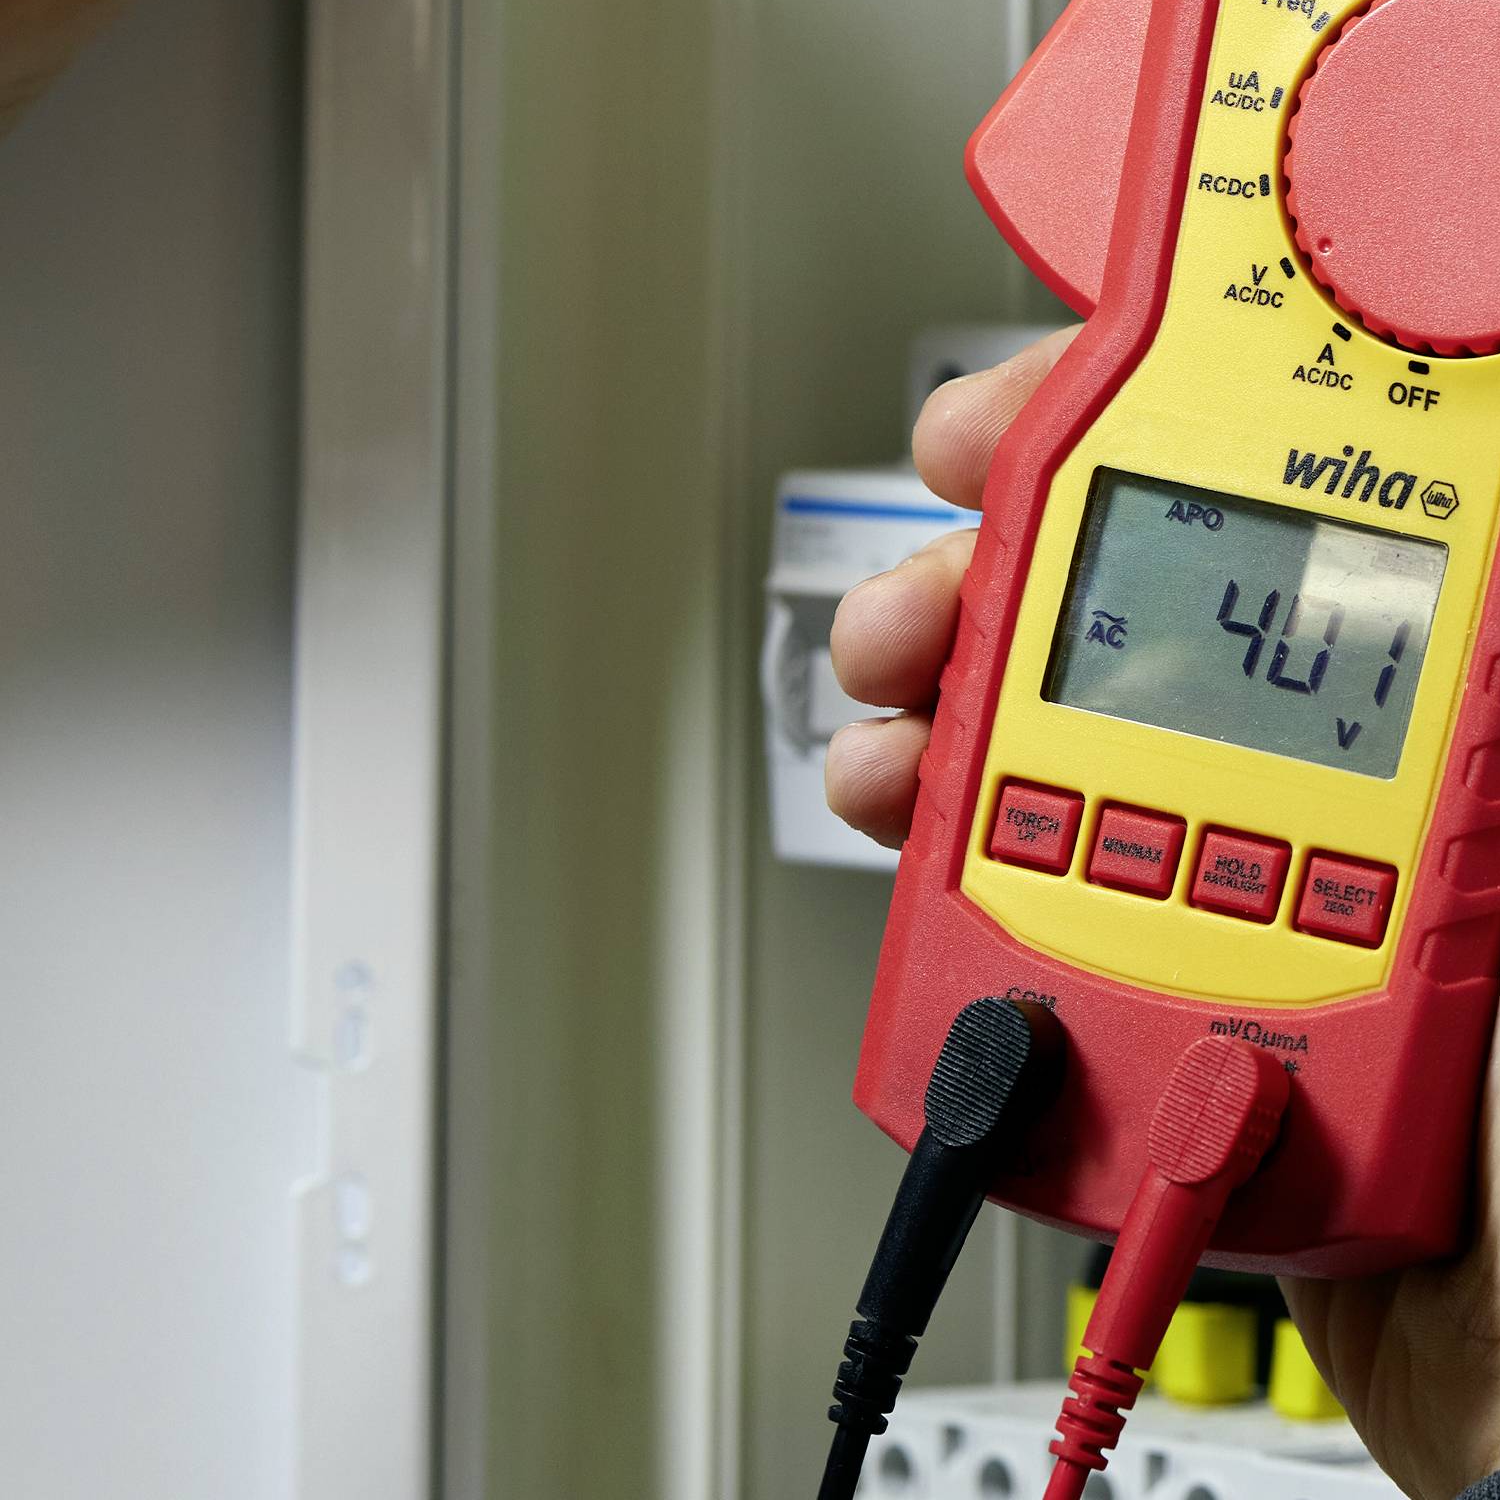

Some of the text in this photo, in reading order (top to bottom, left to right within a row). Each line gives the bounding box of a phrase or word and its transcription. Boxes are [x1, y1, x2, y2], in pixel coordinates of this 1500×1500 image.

[1210, 89, 1266, 112] AC/DC
[1198, 172, 1257, 199] RCDC
[1251, 263, 1269, 286] V
[1223, 283, 1285, 309] AC/DC
[1317, 343, 1336, 367] A
[1291, 365, 1354, 392] AC/DC
[1387, 382, 1441, 412] OFF
[1281, 444, 1418, 511] wiha
[1164, 499, 1225, 533] APO
[1085, 579, 1412, 709] AC 401
[1335, 717, 1362, 751] V
[1005, 806, 1062, 834] TORCH
[1215, 855, 1262, 881] HOLD
[1313, 878, 1378, 906] SELECT
